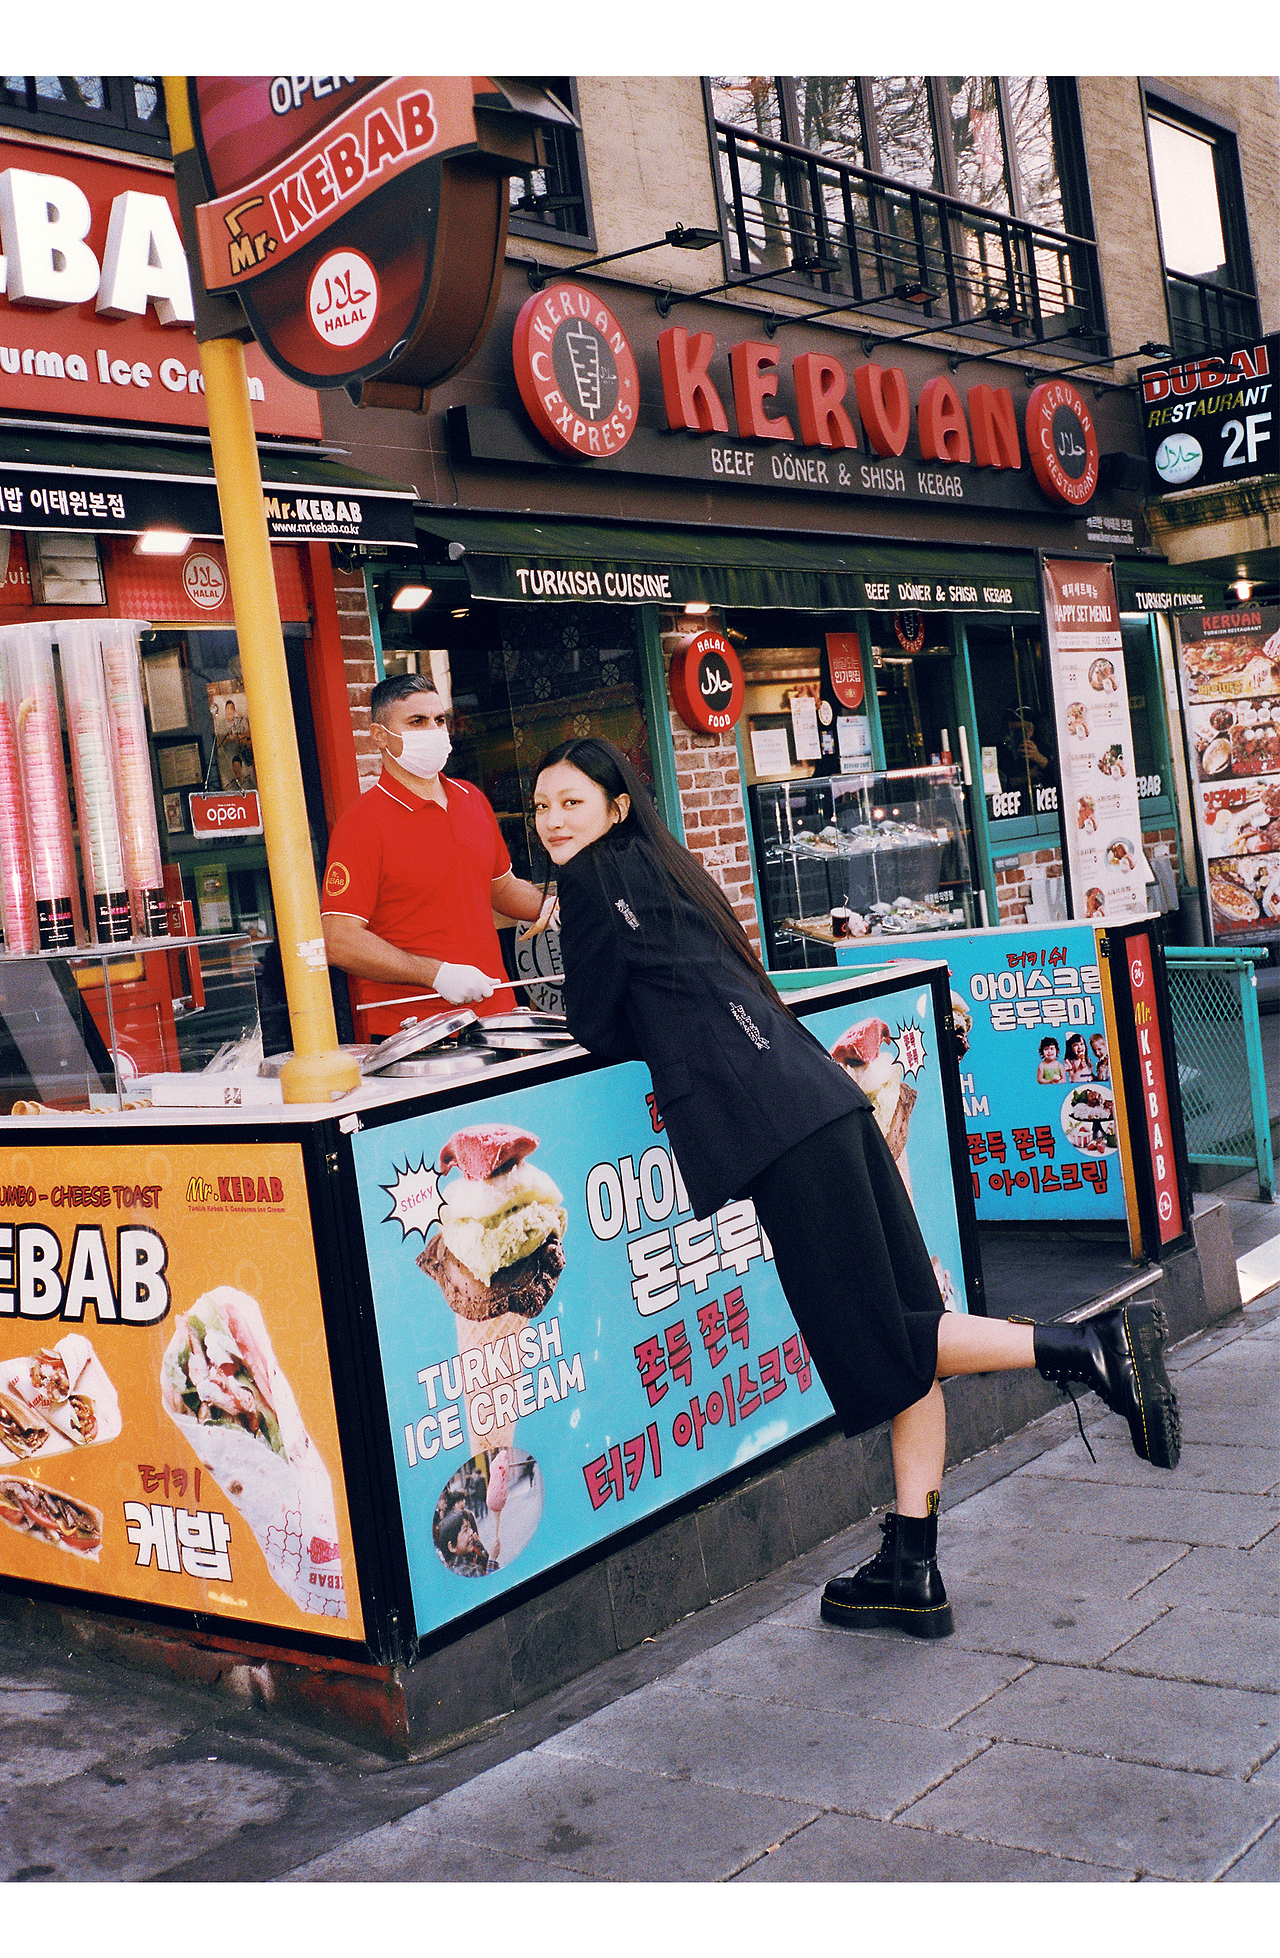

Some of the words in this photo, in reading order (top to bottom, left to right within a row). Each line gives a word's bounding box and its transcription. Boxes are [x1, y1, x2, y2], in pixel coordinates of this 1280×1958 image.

[268, 89, 438, 243] KEBAB
[324, 307, 368, 334] HALAL
[534, 291, 625, 355] KERVAN
[96, 349, 152, 388] Ice
[1142, 344, 1270, 404] DUBAI
[658, 325, 1022, 469] KERVAN
[1041, 385, 1091, 433] KERVAN
[1147, 383, 1273, 428] RESTAURANT
[543, 389, 632, 452] EXPRESS
[1220, 411, 1273, 468] 2F
[711, 447, 755, 477] BEEF
[772, 452, 830, 485] DÖNER
[838, 462, 852, 486] &
[860, 464, 906, 492] SHISH
[917, 471, 964, 498] KEBAB
[1046, 452, 1096, 500] RESTAURANT
[30, 488, 125, 519] 이태원본점
[272, 521, 360, 536] www.mrkebab.co.kr
[193, 589, 220, 598] HALAL
[516, 568, 602, 596] TURKISH
[604, 572, 672, 599] CUISINE
[865, 582, 890, 601] BEEF
[898, 582, 931, 602] DÖNER
[935, 585, 946, 602] &
[948, 585, 978, 603] SHISH
[983, 586, 1013, 604] KEBAB
[1135, 592, 1172, 610] TURKISH
[1054, 604, 1076, 622] HAPPY
[1076, 605, 1089, 622] SET
[1088, 605, 1112, 623] MENU
[1202, 611, 1262, 631] KERVAN
[1227, 625, 1262, 634] RESTAURANT
[696, 637, 726, 653] HALAL
[707, 713, 731, 728] FOOD
[206, 806, 247, 826] open
[992, 790, 1022, 818] BEEF
[989, 996, 1096, 1032] 돈두루마
[1134, 1000, 1152, 1027] Mr.
[1140, 1028, 1167, 1182] KEBAB
[1012, 1124, 1056, 1162] 쫀득
[988, 1159, 1109, 1197] 아이스크림
[50, 1185, 112, 1209] CHEESE
[112, 1185, 163, 1210] TOAST
[399, 1184, 435, 1214] Sticky
[626, 1196, 776, 1318] 돈두루
[416, 1316, 564, 1410] TURKISH
[633, 1318, 695, 1408] 쫀득
[697, 1284, 751, 1371] 쫀득
[404, 1412, 465, 1468] ICE
[469, 1353, 587, 1437] CREAM
[582, 1428, 663, 1512] 터키
[672, 1331, 814, 1452] 아이스크림
[138, 1463, 202, 1505] 터키
[123, 1500, 233, 1583] 케밥
